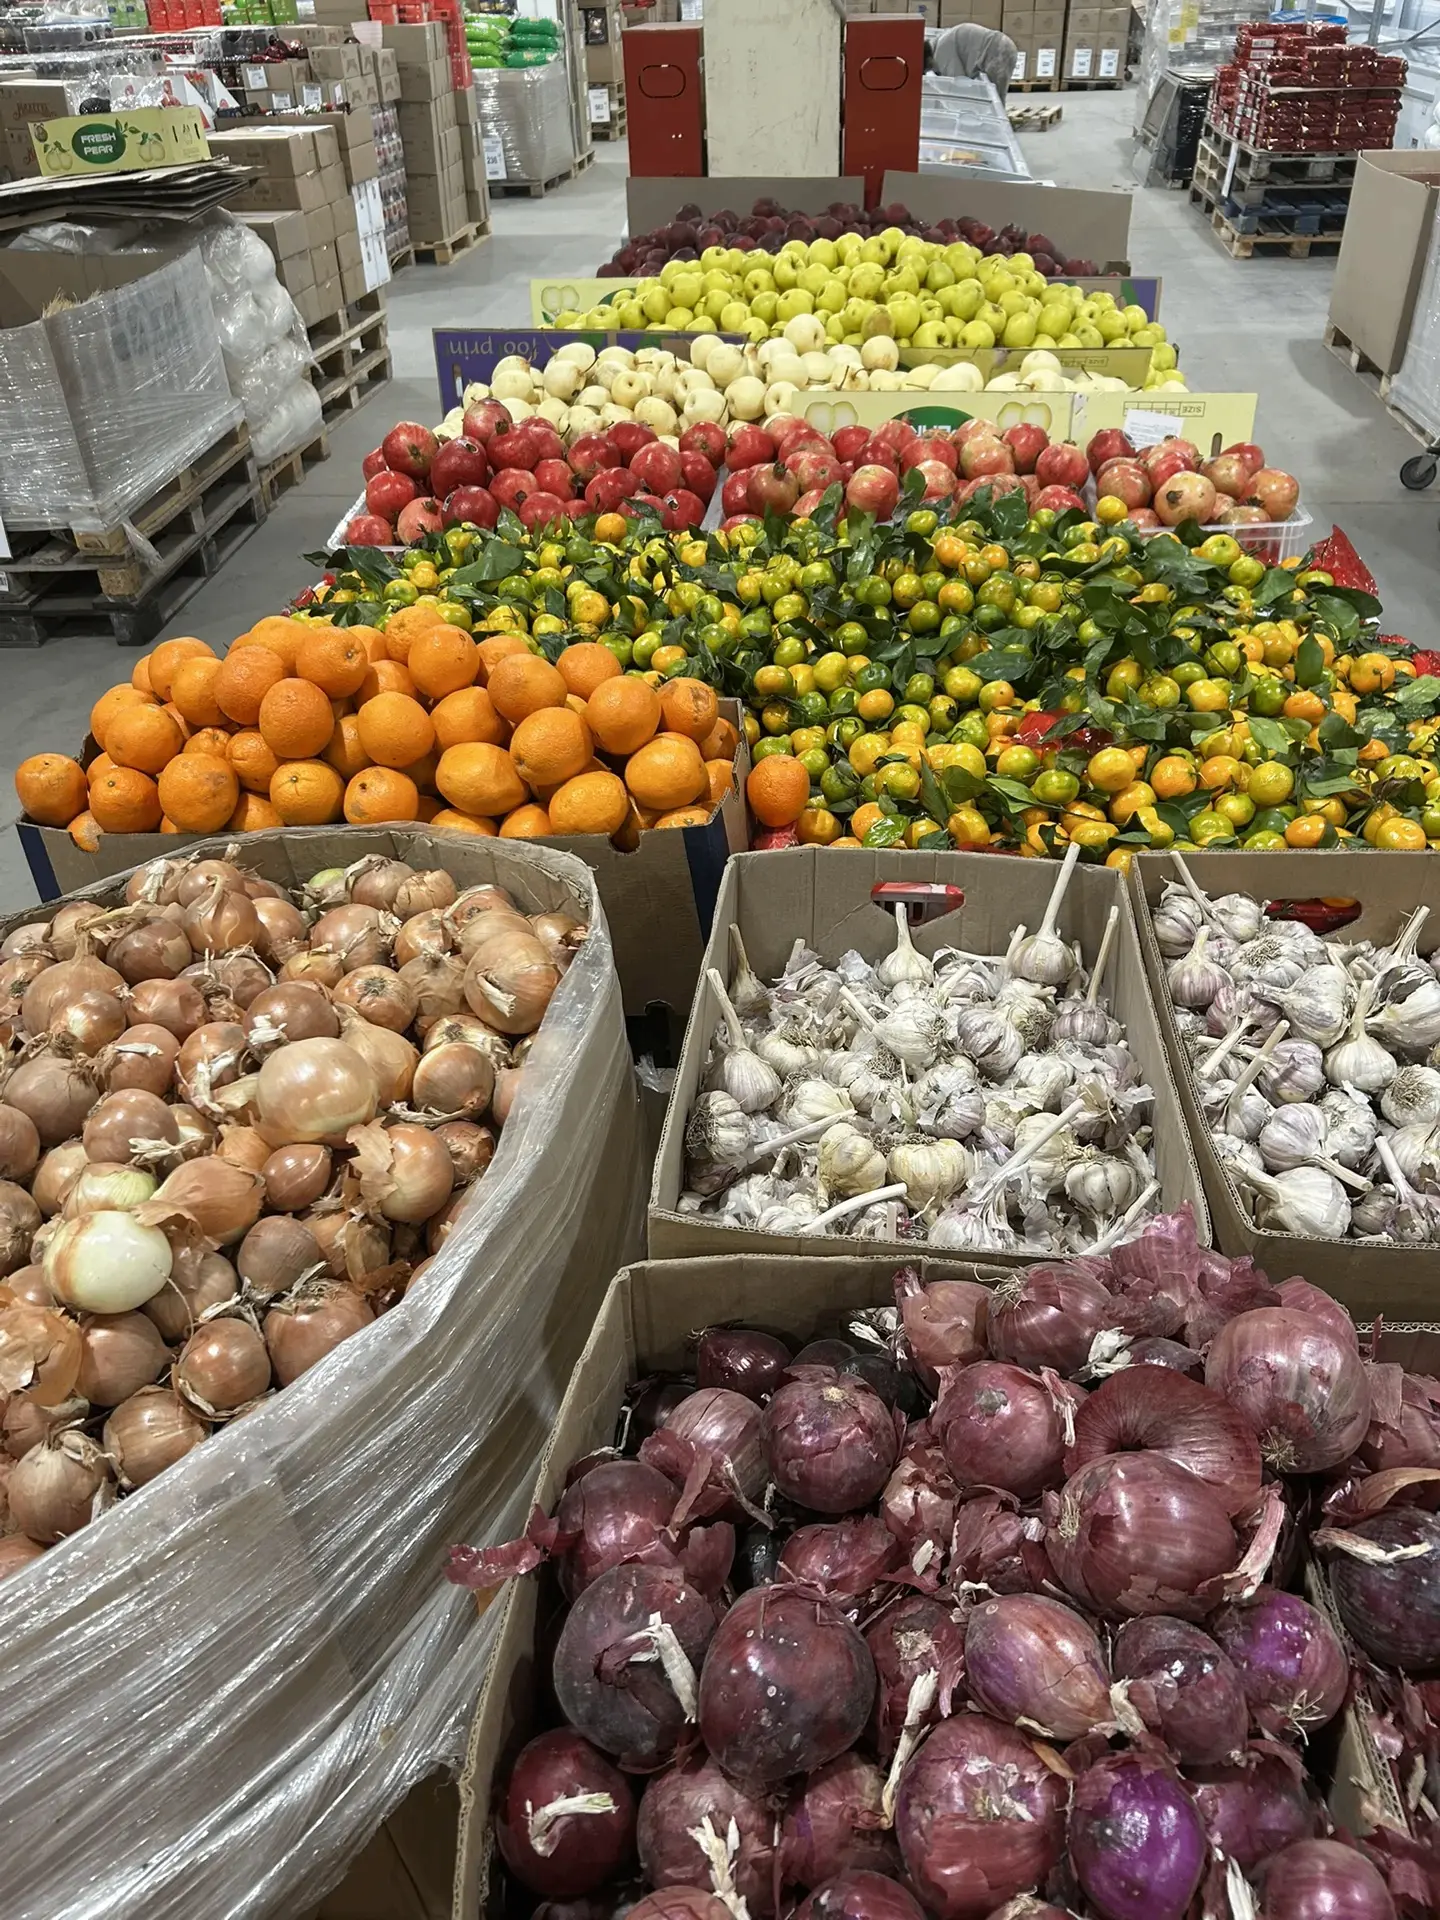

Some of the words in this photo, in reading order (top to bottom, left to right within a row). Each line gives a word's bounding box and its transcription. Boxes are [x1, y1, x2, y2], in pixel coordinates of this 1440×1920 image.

[80, 132, 117, 144] FRESH
[83, 144, 114, 156] PEAR
[1182, 405, 1203, 414] SIZE
